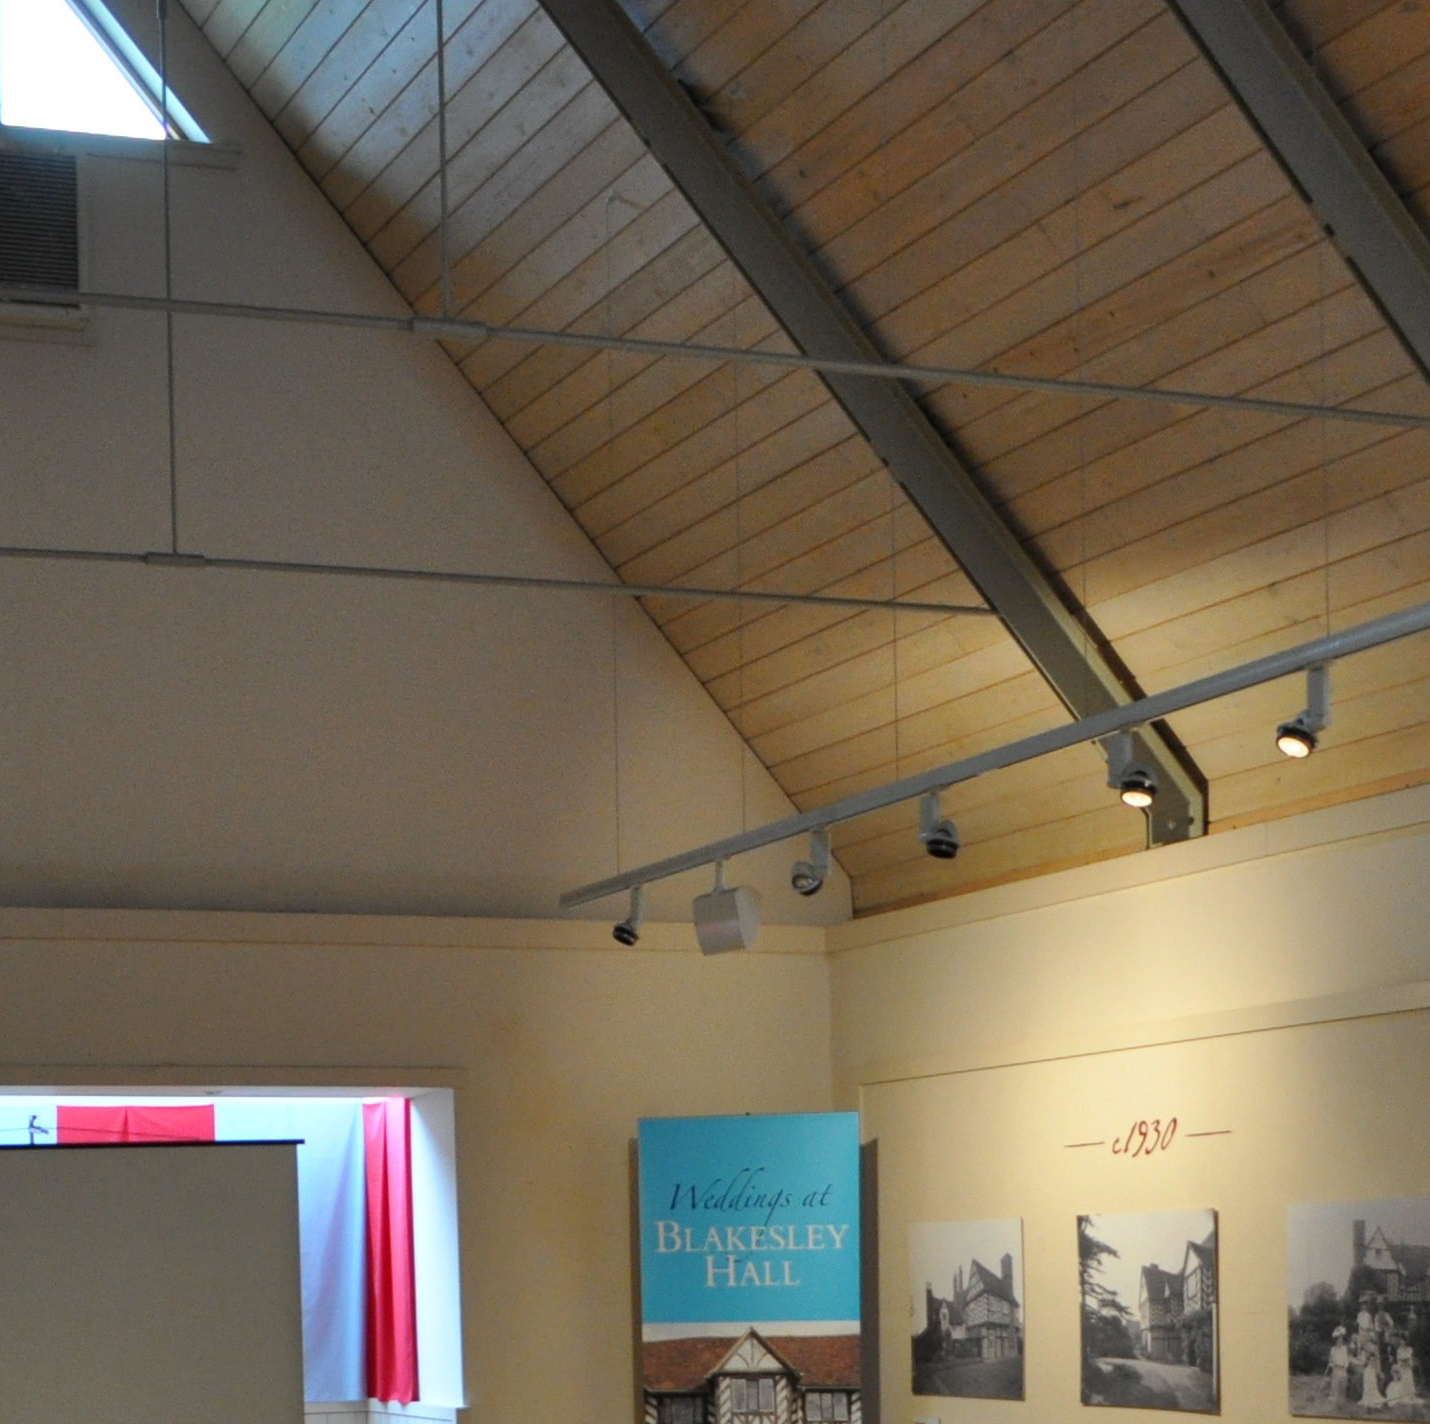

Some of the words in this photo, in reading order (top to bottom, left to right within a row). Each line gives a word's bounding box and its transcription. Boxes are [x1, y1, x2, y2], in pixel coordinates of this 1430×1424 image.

[1112, 1117, 1177, 1158] c1930
[669, 1167, 793, 1238] Weddings
[802, 1183, 833, 1207] at
[655, 1219, 849, 1253] BLAKESLEY
[705, 1254, 801, 1287] HALL
